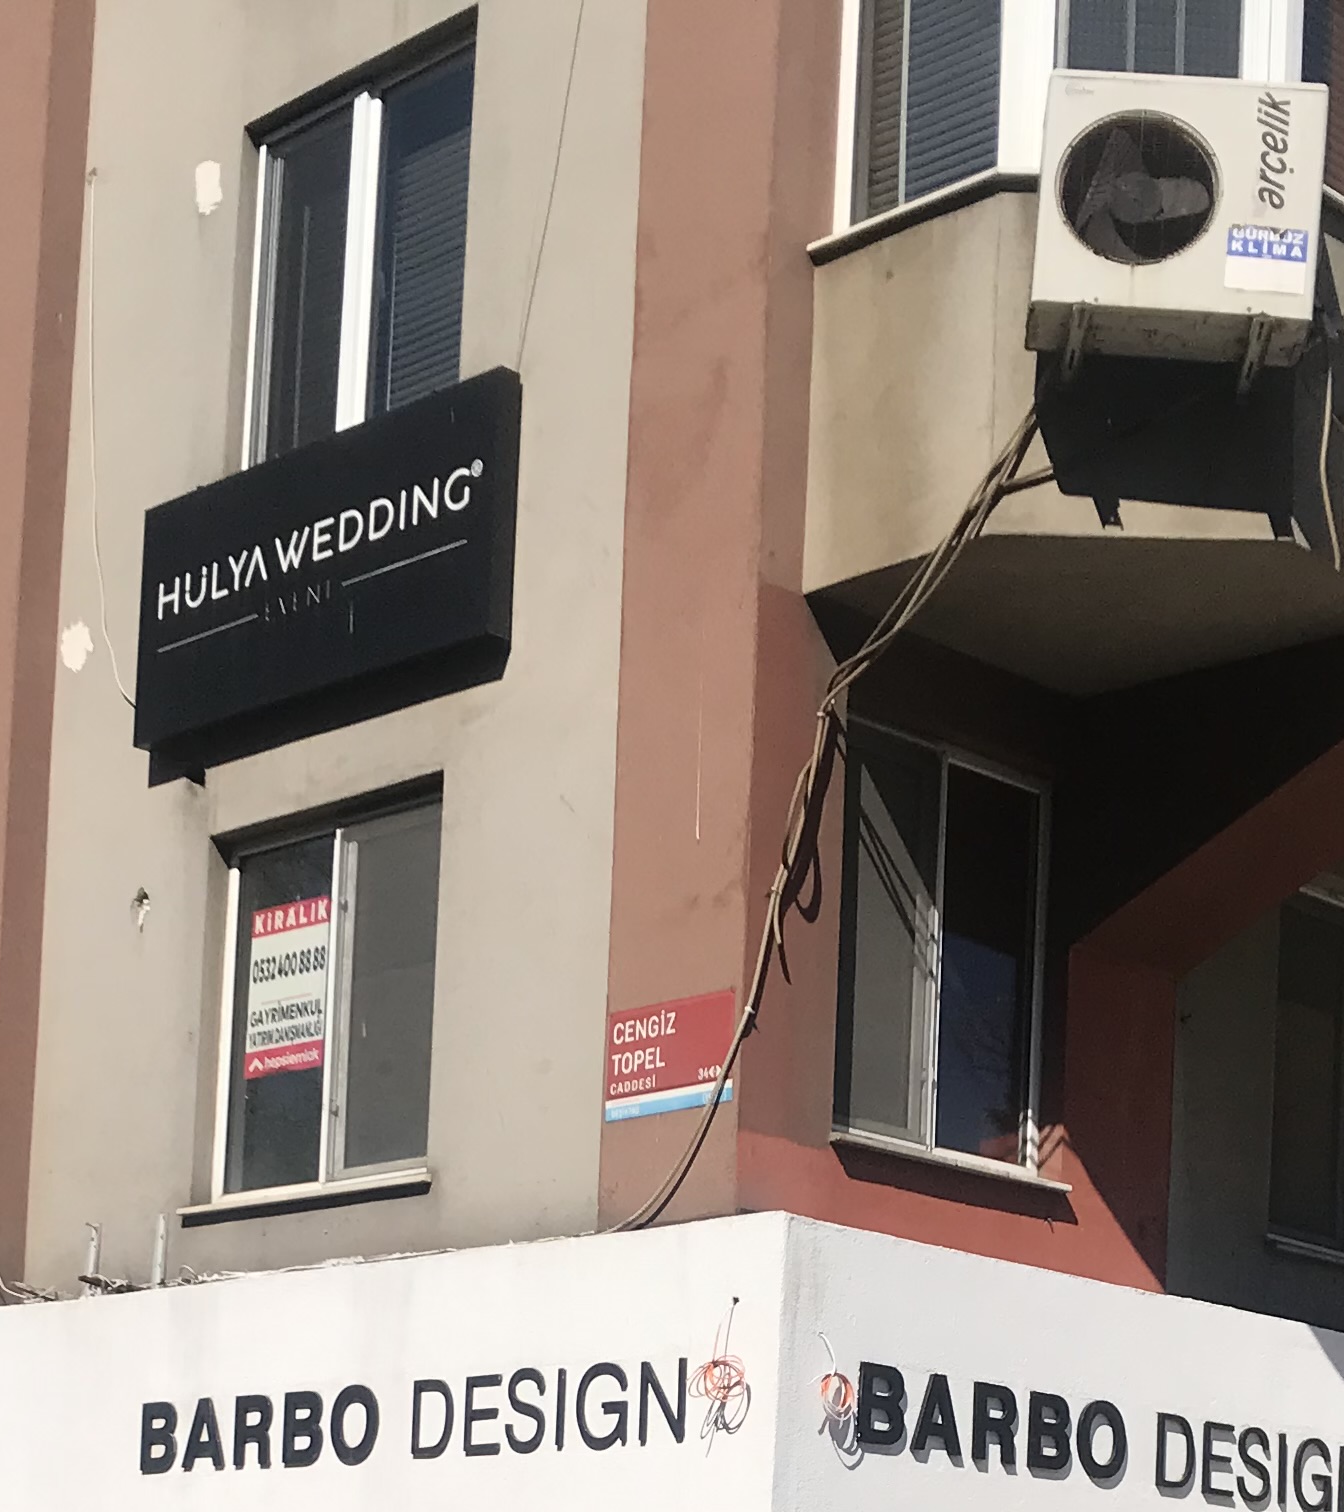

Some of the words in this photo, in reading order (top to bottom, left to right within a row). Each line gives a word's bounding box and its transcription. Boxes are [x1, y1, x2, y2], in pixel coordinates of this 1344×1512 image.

[1257, 91, 1294, 210] arçelik
[274, 466, 472, 574] WEDDING
[612, 1046, 665, 1076] TOPEL
[613, 1009, 676, 1045] CENGİZ
[140, 1384, 380, 1476] BARBO
[410, 1357, 688, 1461] DESIGN
[857, 1361, 1127, 1482] BARBO
